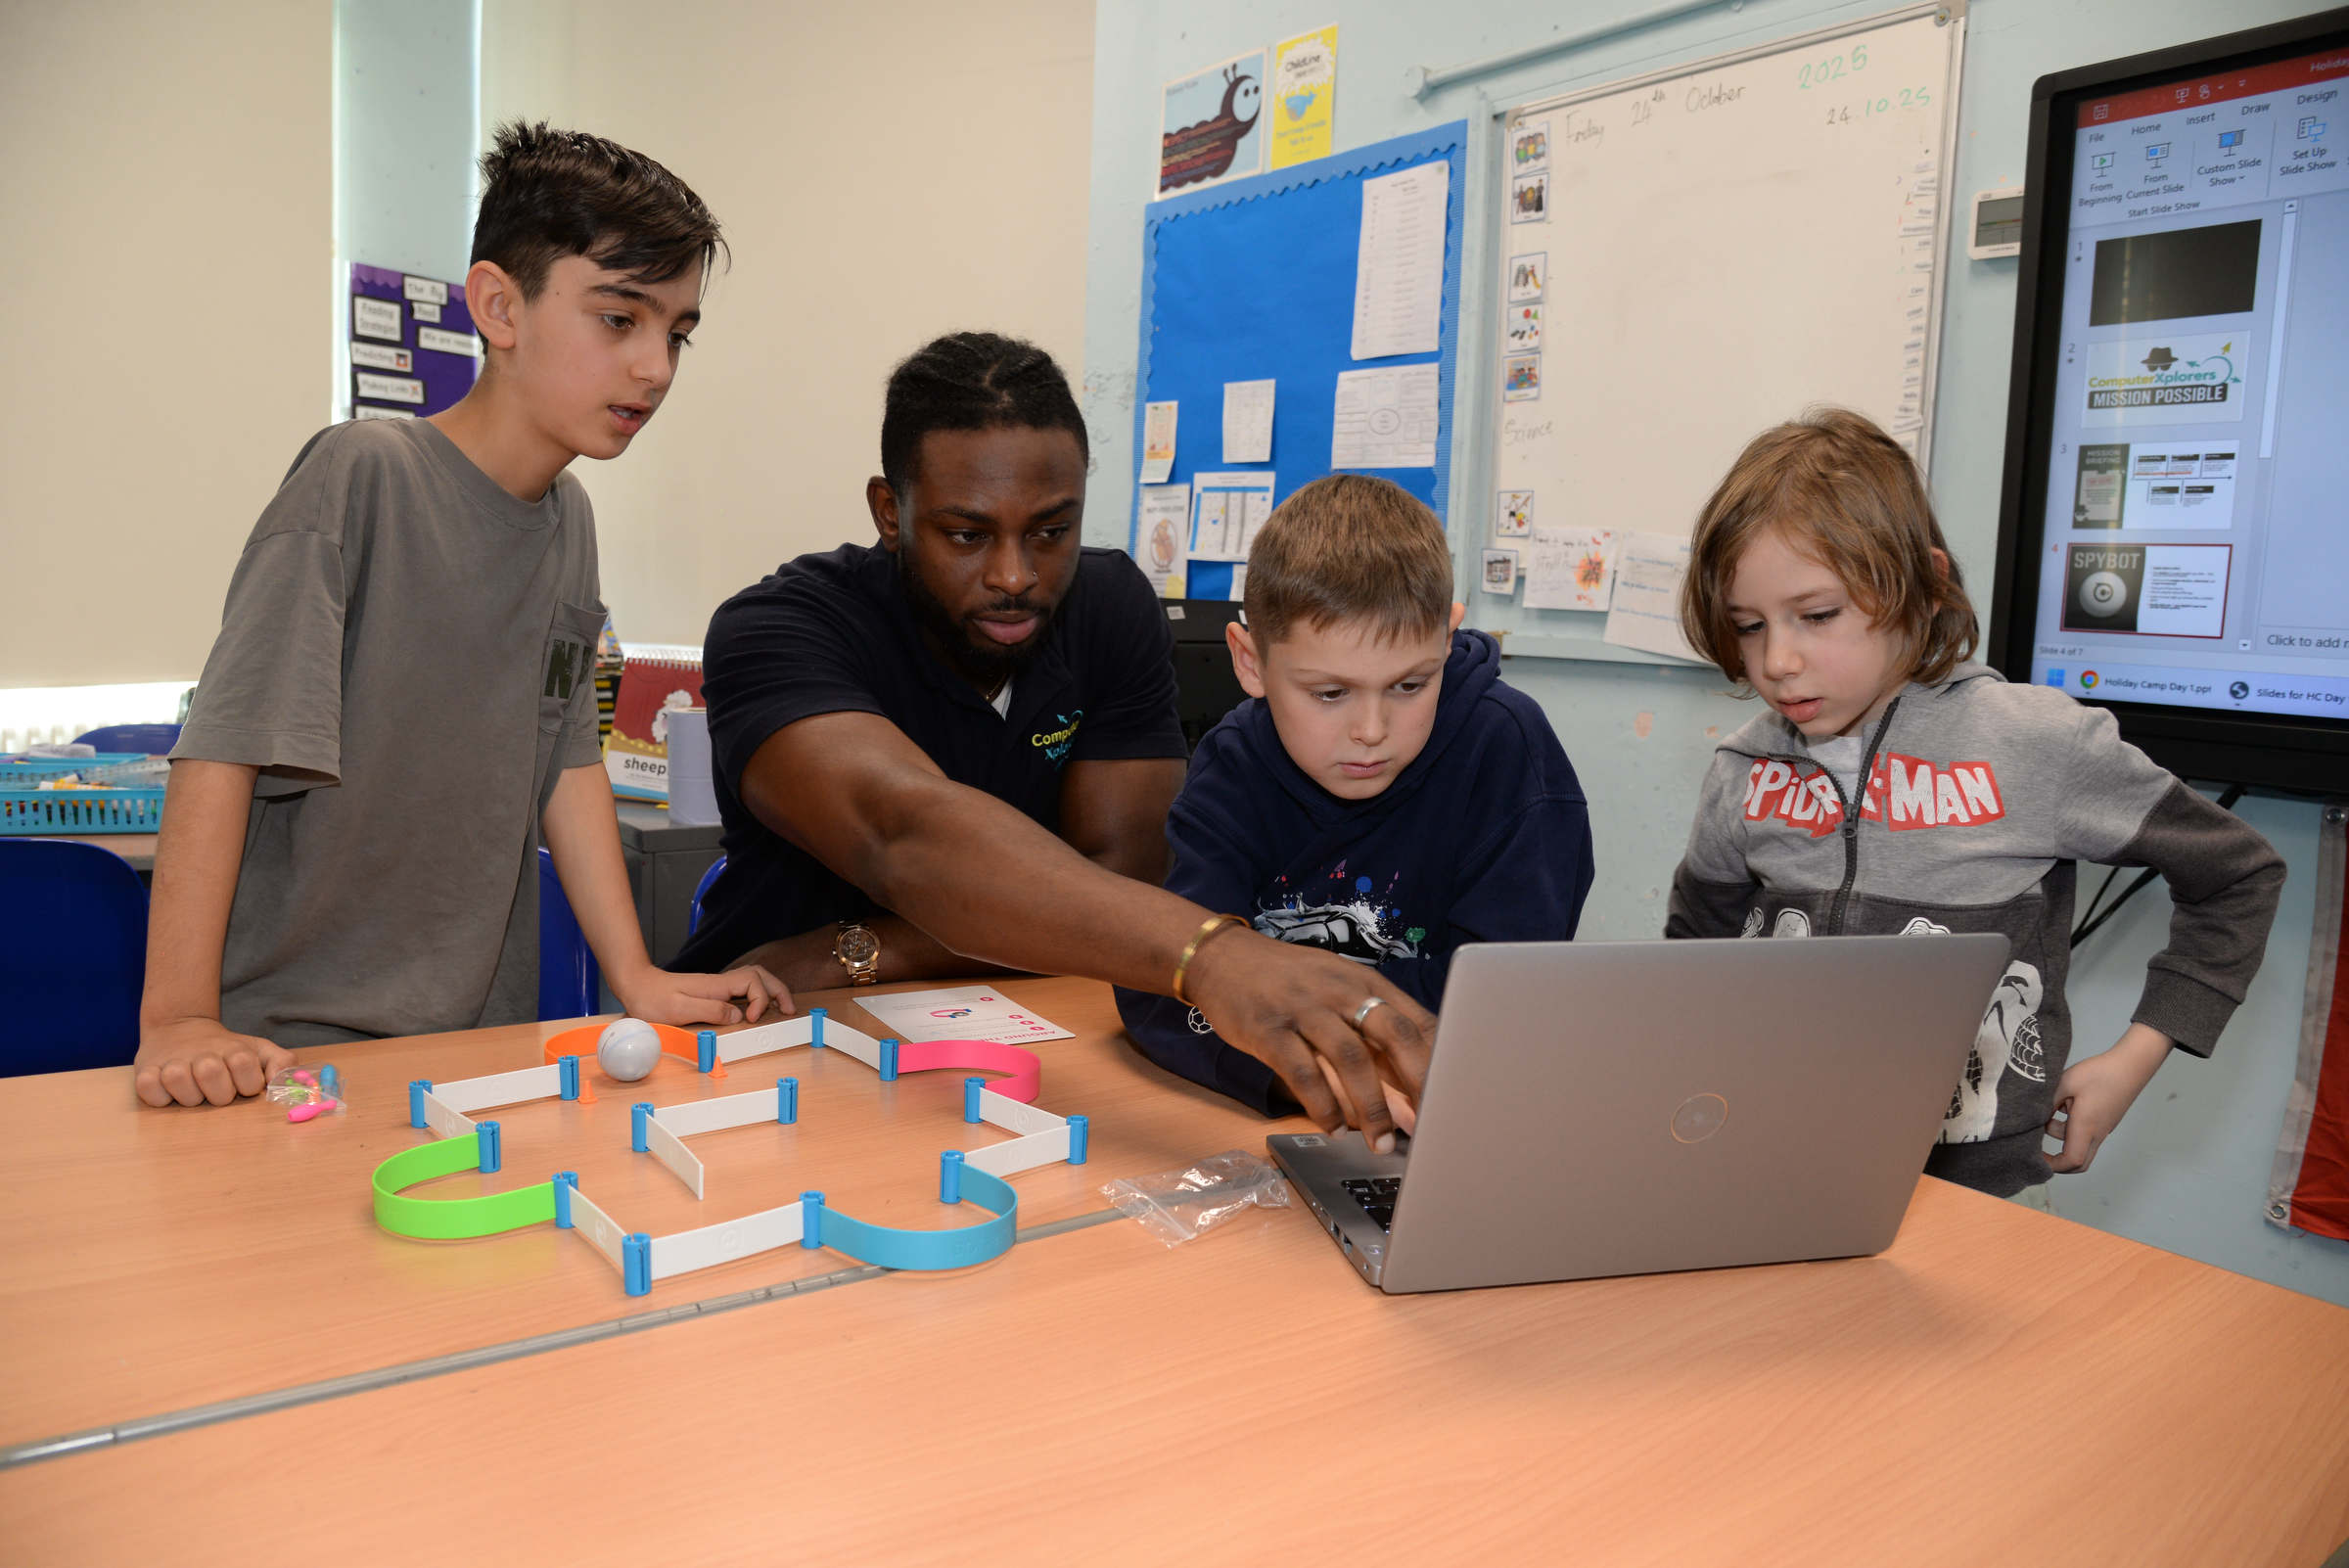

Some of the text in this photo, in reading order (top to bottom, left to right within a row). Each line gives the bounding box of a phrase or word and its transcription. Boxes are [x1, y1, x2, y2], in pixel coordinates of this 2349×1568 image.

[1799, 44, 1867, 89] 2025
[1684, 82, 1746, 113] October
[2089, 89, 2338, 144] File Home Insert Draw Design
[2292, 146, 2326, 161] Set Up
[2197, 158, 2262, 175] Custom Slide
[2280, 159, 2337, 176] Slide Show
[2143, 172, 2168, 184] From
[2209, 174, 2236, 187] Show
[2090, 182, 2113, 192] From
[2126, 183, 2185, 200] Current Slide
[2078, 193, 2123, 208] Beginning
[2128, 200, 2200, 218] Start Slide Show
[2089, 369, 2217, 389] ComputerXplorers
[2093, 385, 2224, 408] MISSION POSSIBLE
[2074, 552, 2141, 571] SPYBOT
[2267, 634, 2296, 646] Click
[2299, 636, 2312, 647] to
[2316, 637, 2341, 648] add
[2105, 676, 2139, 690] Holiday
[2141, 680, 2166, 693] Camp
[2169, 682, 2188, 694] Day
[2257, 688, 2345, 705] Slides for HC Day
[623, 757, 668, 776] sheep
